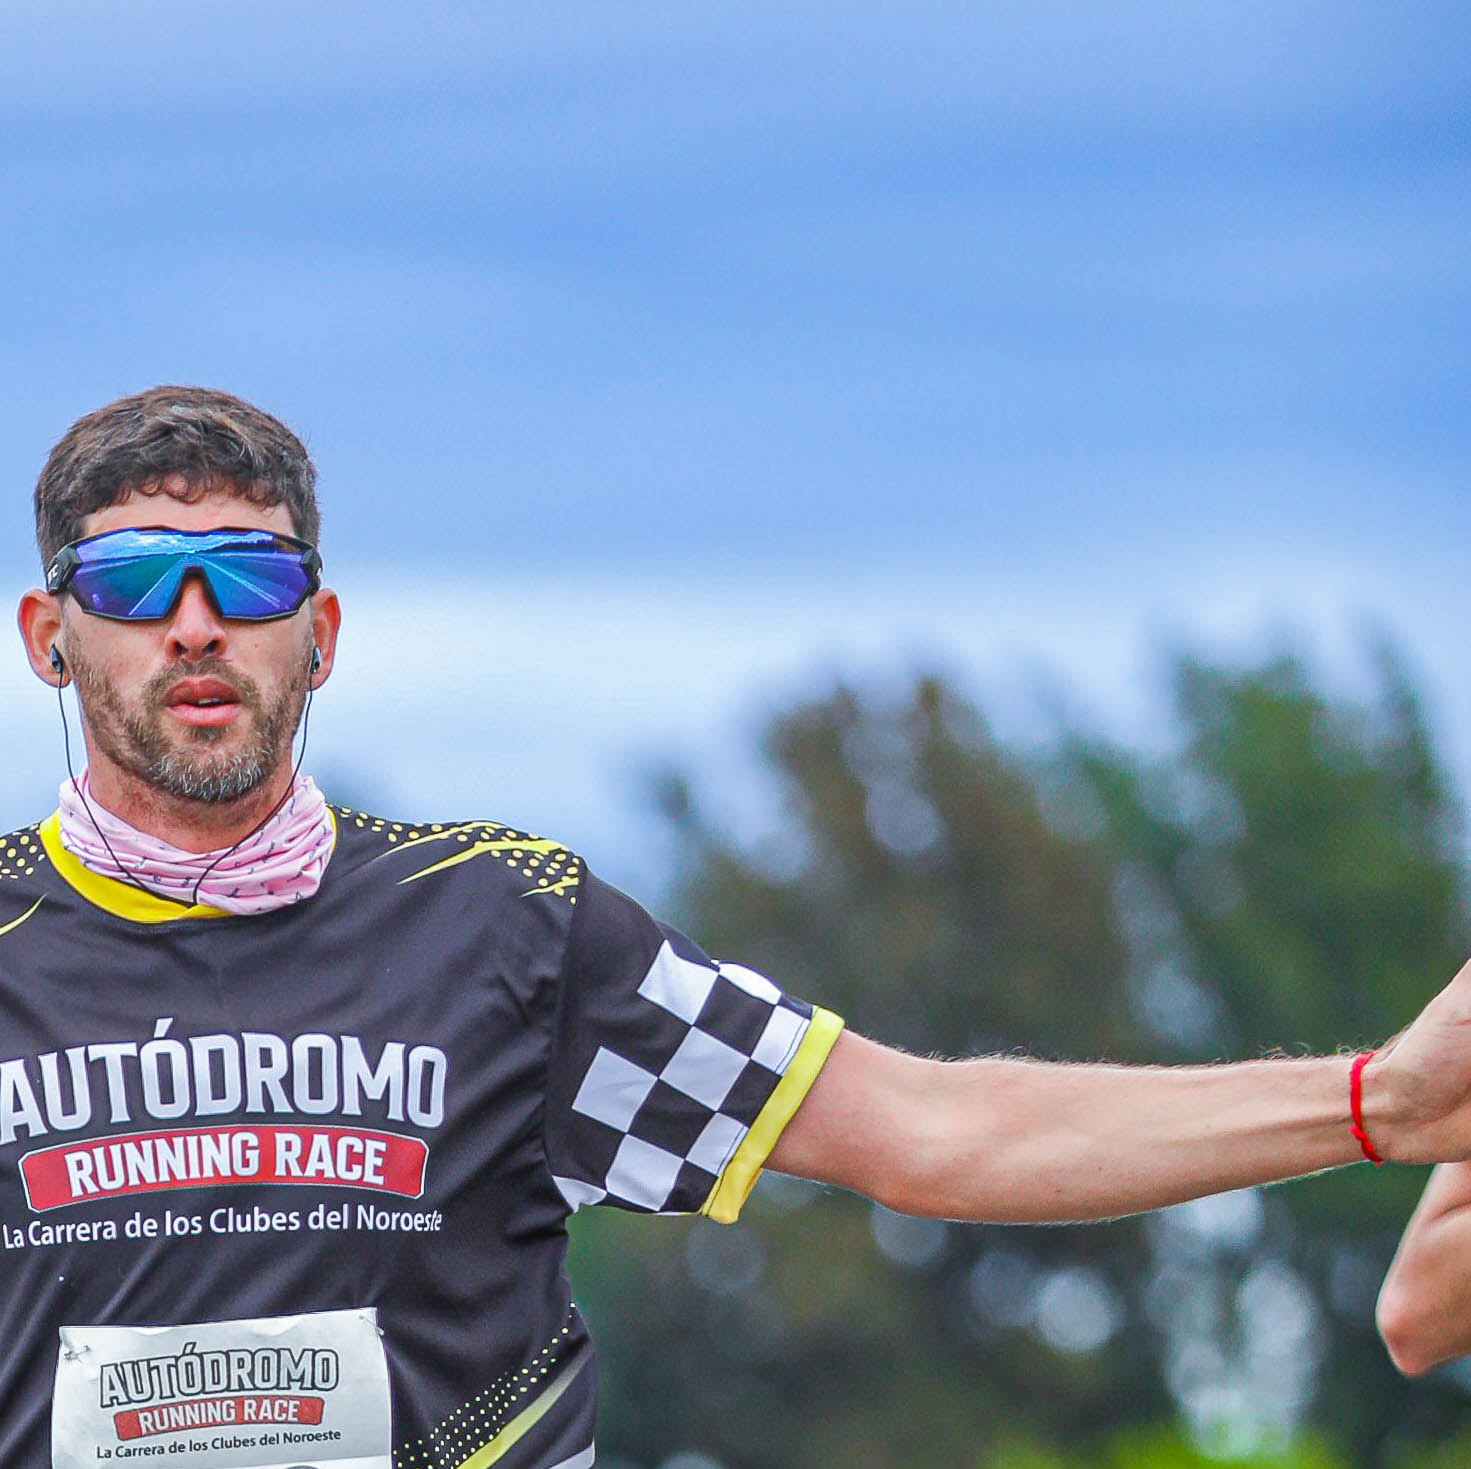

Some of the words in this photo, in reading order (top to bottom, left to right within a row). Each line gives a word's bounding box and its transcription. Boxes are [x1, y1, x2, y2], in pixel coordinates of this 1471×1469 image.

[64, 1132, 261, 1197] RUNNING
[274, 1130, 387, 1187] RACE
[3, 1224, 24, 1249] La
[28, 1220, 117, 1246] Carrera
[125, 1211, 159, 1238] de
[165, 1210, 202, 1236] los
[210, 1206, 300, 1233] Clubes
[308, 1203, 349, 1230] del
[357, 1204, 443, 1232] Noroeste
[100, 1342, 339, 1408] AUTÓDROMO
[139, 1401, 236, 1435] RUNNING
[244, 1398, 299, 1423] RACE
[96, 1446, 112, 1459] La
[115, 1445, 165, 1458] Carrera
[168, 1441, 186, 1454] de
[189, 1439, 208, 1452] los
[211, 1436, 256, 1450] Clubes
[259, 1433, 280, 1446] del
[283, 1430, 341, 1444] Noroeste
